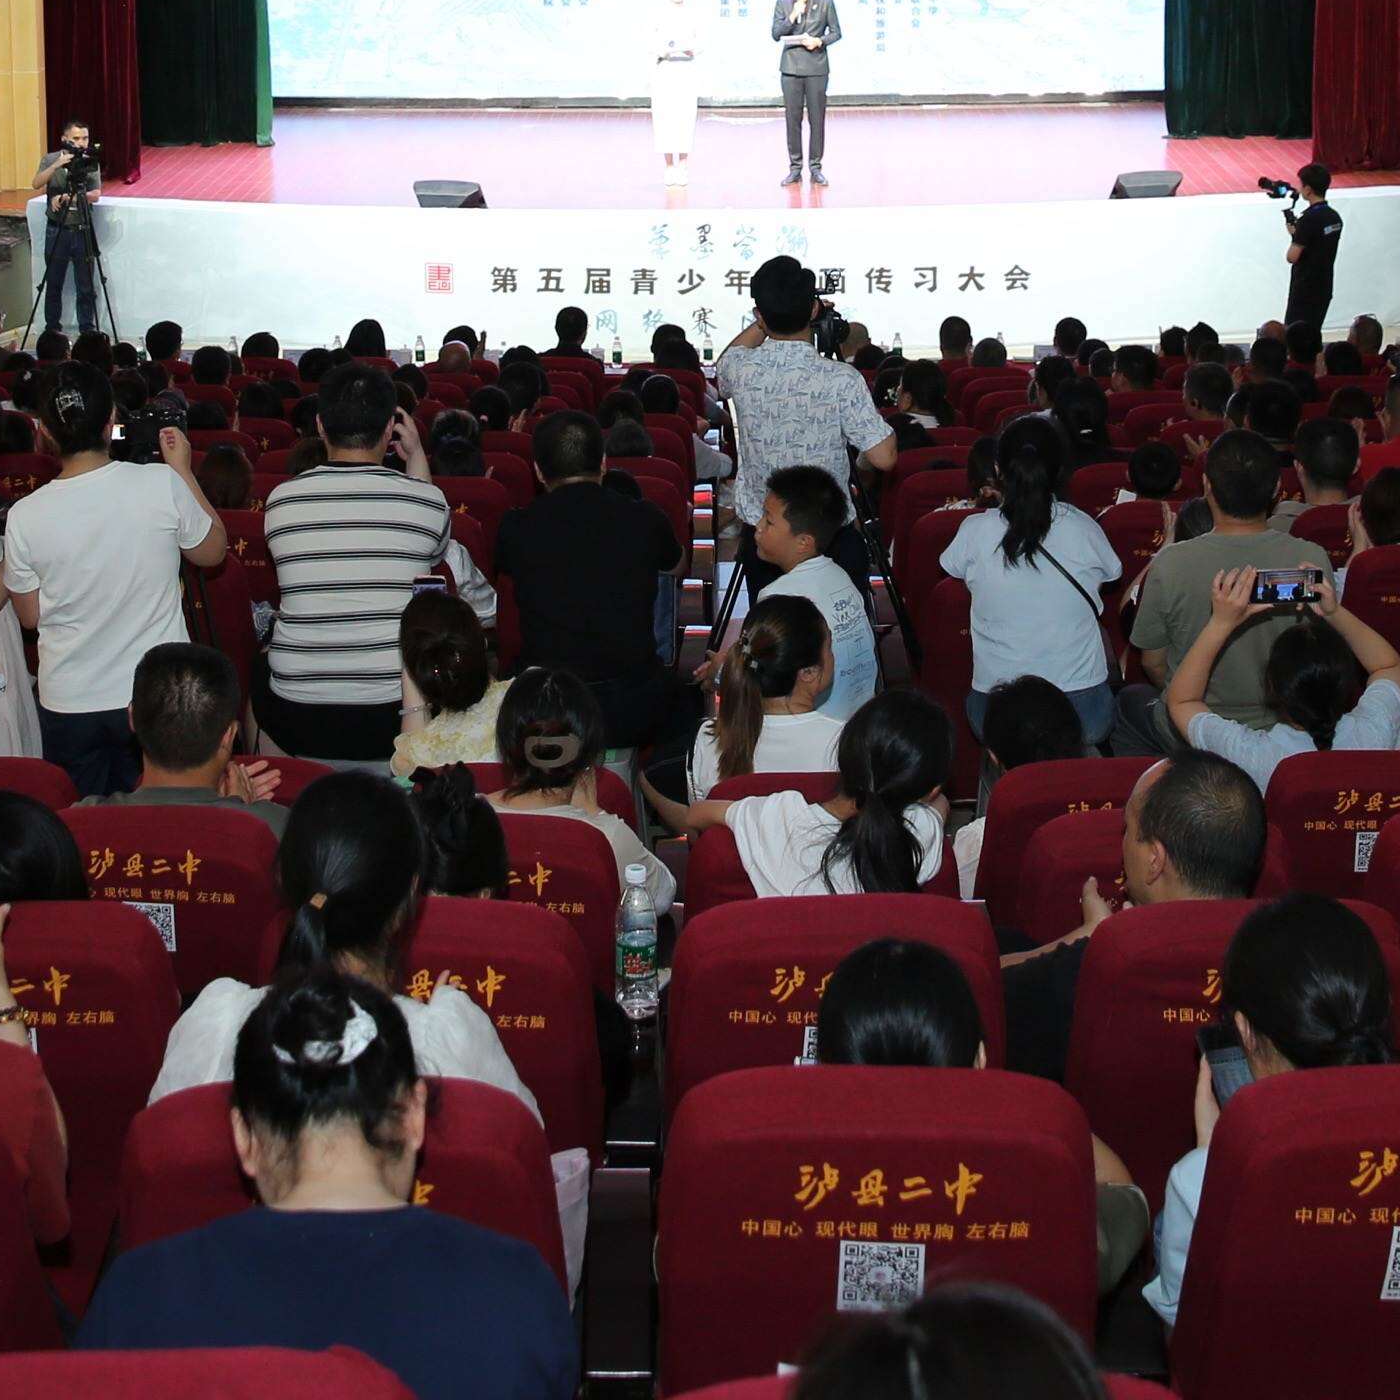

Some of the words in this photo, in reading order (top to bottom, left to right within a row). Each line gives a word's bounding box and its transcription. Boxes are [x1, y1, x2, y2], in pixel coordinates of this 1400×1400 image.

[490, 265, 1033, 296] 第五届青少年画传习大会
[89, 847, 201, 886] 泸县二中
[104, 886, 143, 900] 现代眼
[150, 888, 189, 902] 世界胸
[66, 1010, 117, 1025] 左右脑
[496, 1015, 547, 1029] 左右脑
[728, 1010, 777, 1024] 中国心
[1163, 1008, 1211, 1023] 中国心
[794, 1161, 984, 1216] 泸县二中
[1295, 1207, 1357, 1225] 中国心
[741, 1218, 803, 1238] 中国心
[815, 1220, 879, 1239] 现代眼
[891, 1222, 955, 1241] 世界胸
[966, 1220, 1031, 1241] 左右脑
